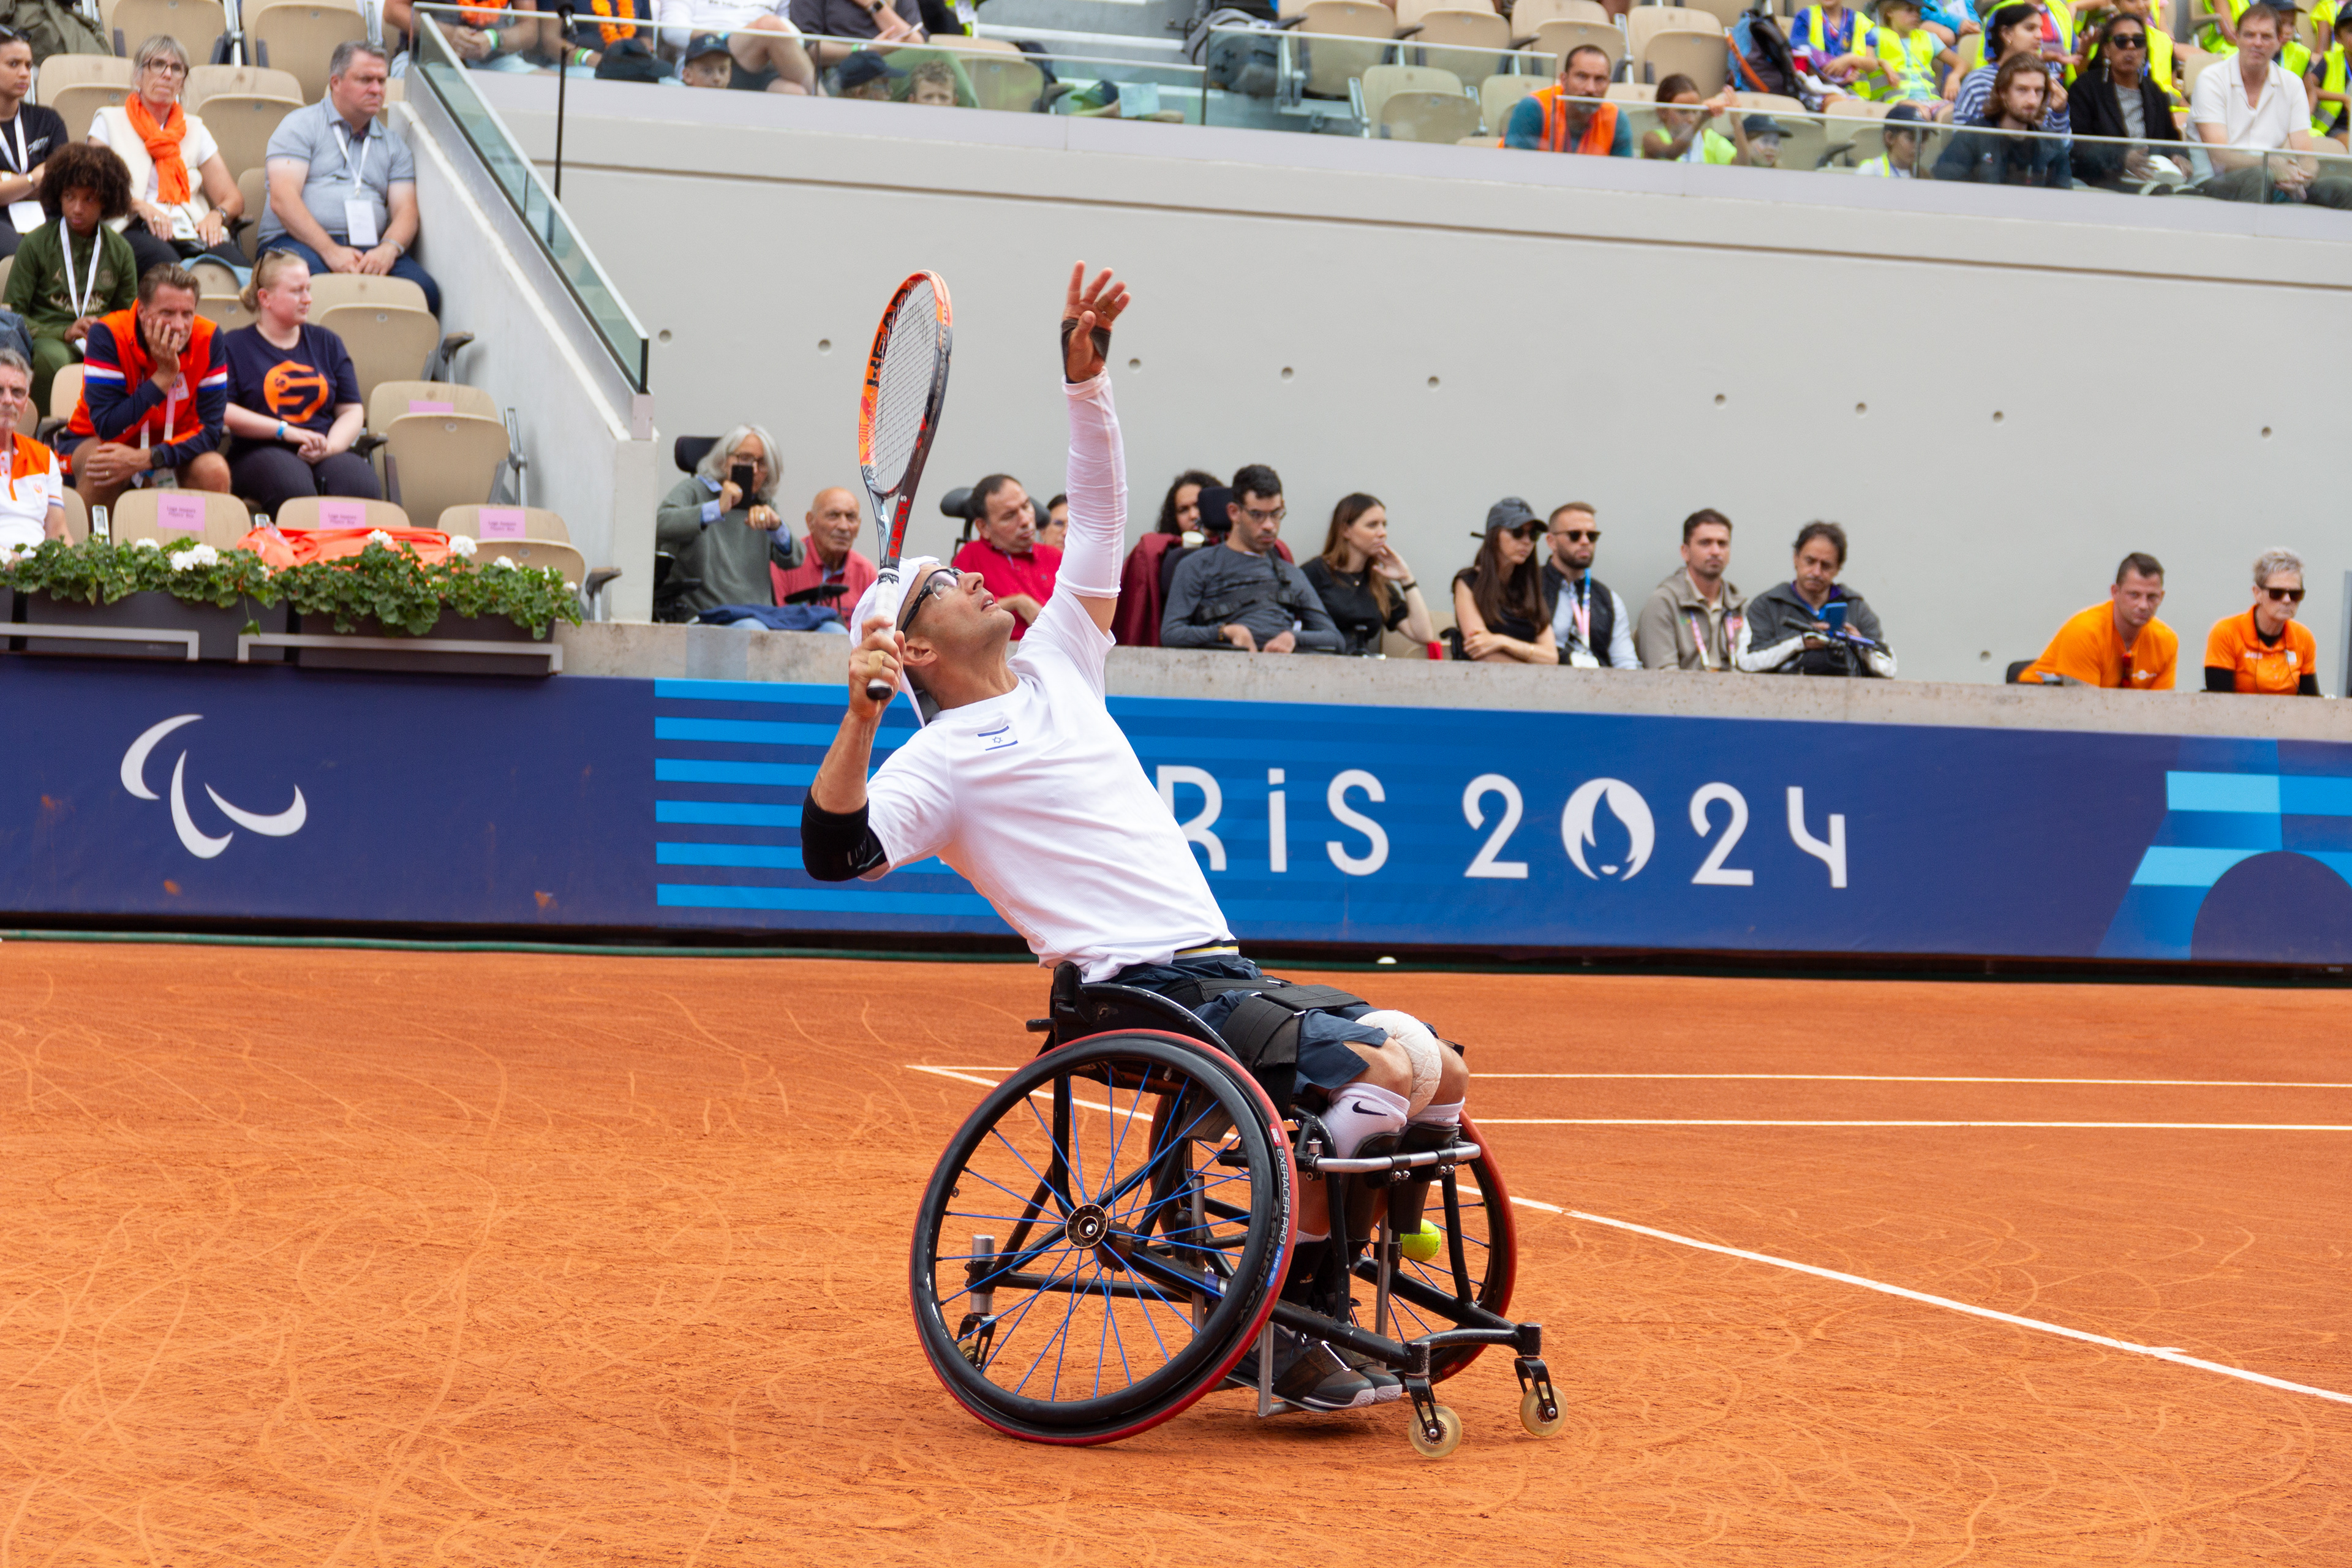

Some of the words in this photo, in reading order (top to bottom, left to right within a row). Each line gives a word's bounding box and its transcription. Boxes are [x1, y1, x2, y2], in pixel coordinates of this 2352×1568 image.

[867, 288, 912, 388] HEAD
[1156, 765, 1389, 876] RiS
[1463, 774, 1847, 888] 2024
[1276, 1149, 1291, 1213] EXERACER
[1279, 1216, 1289, 1245] PRO
